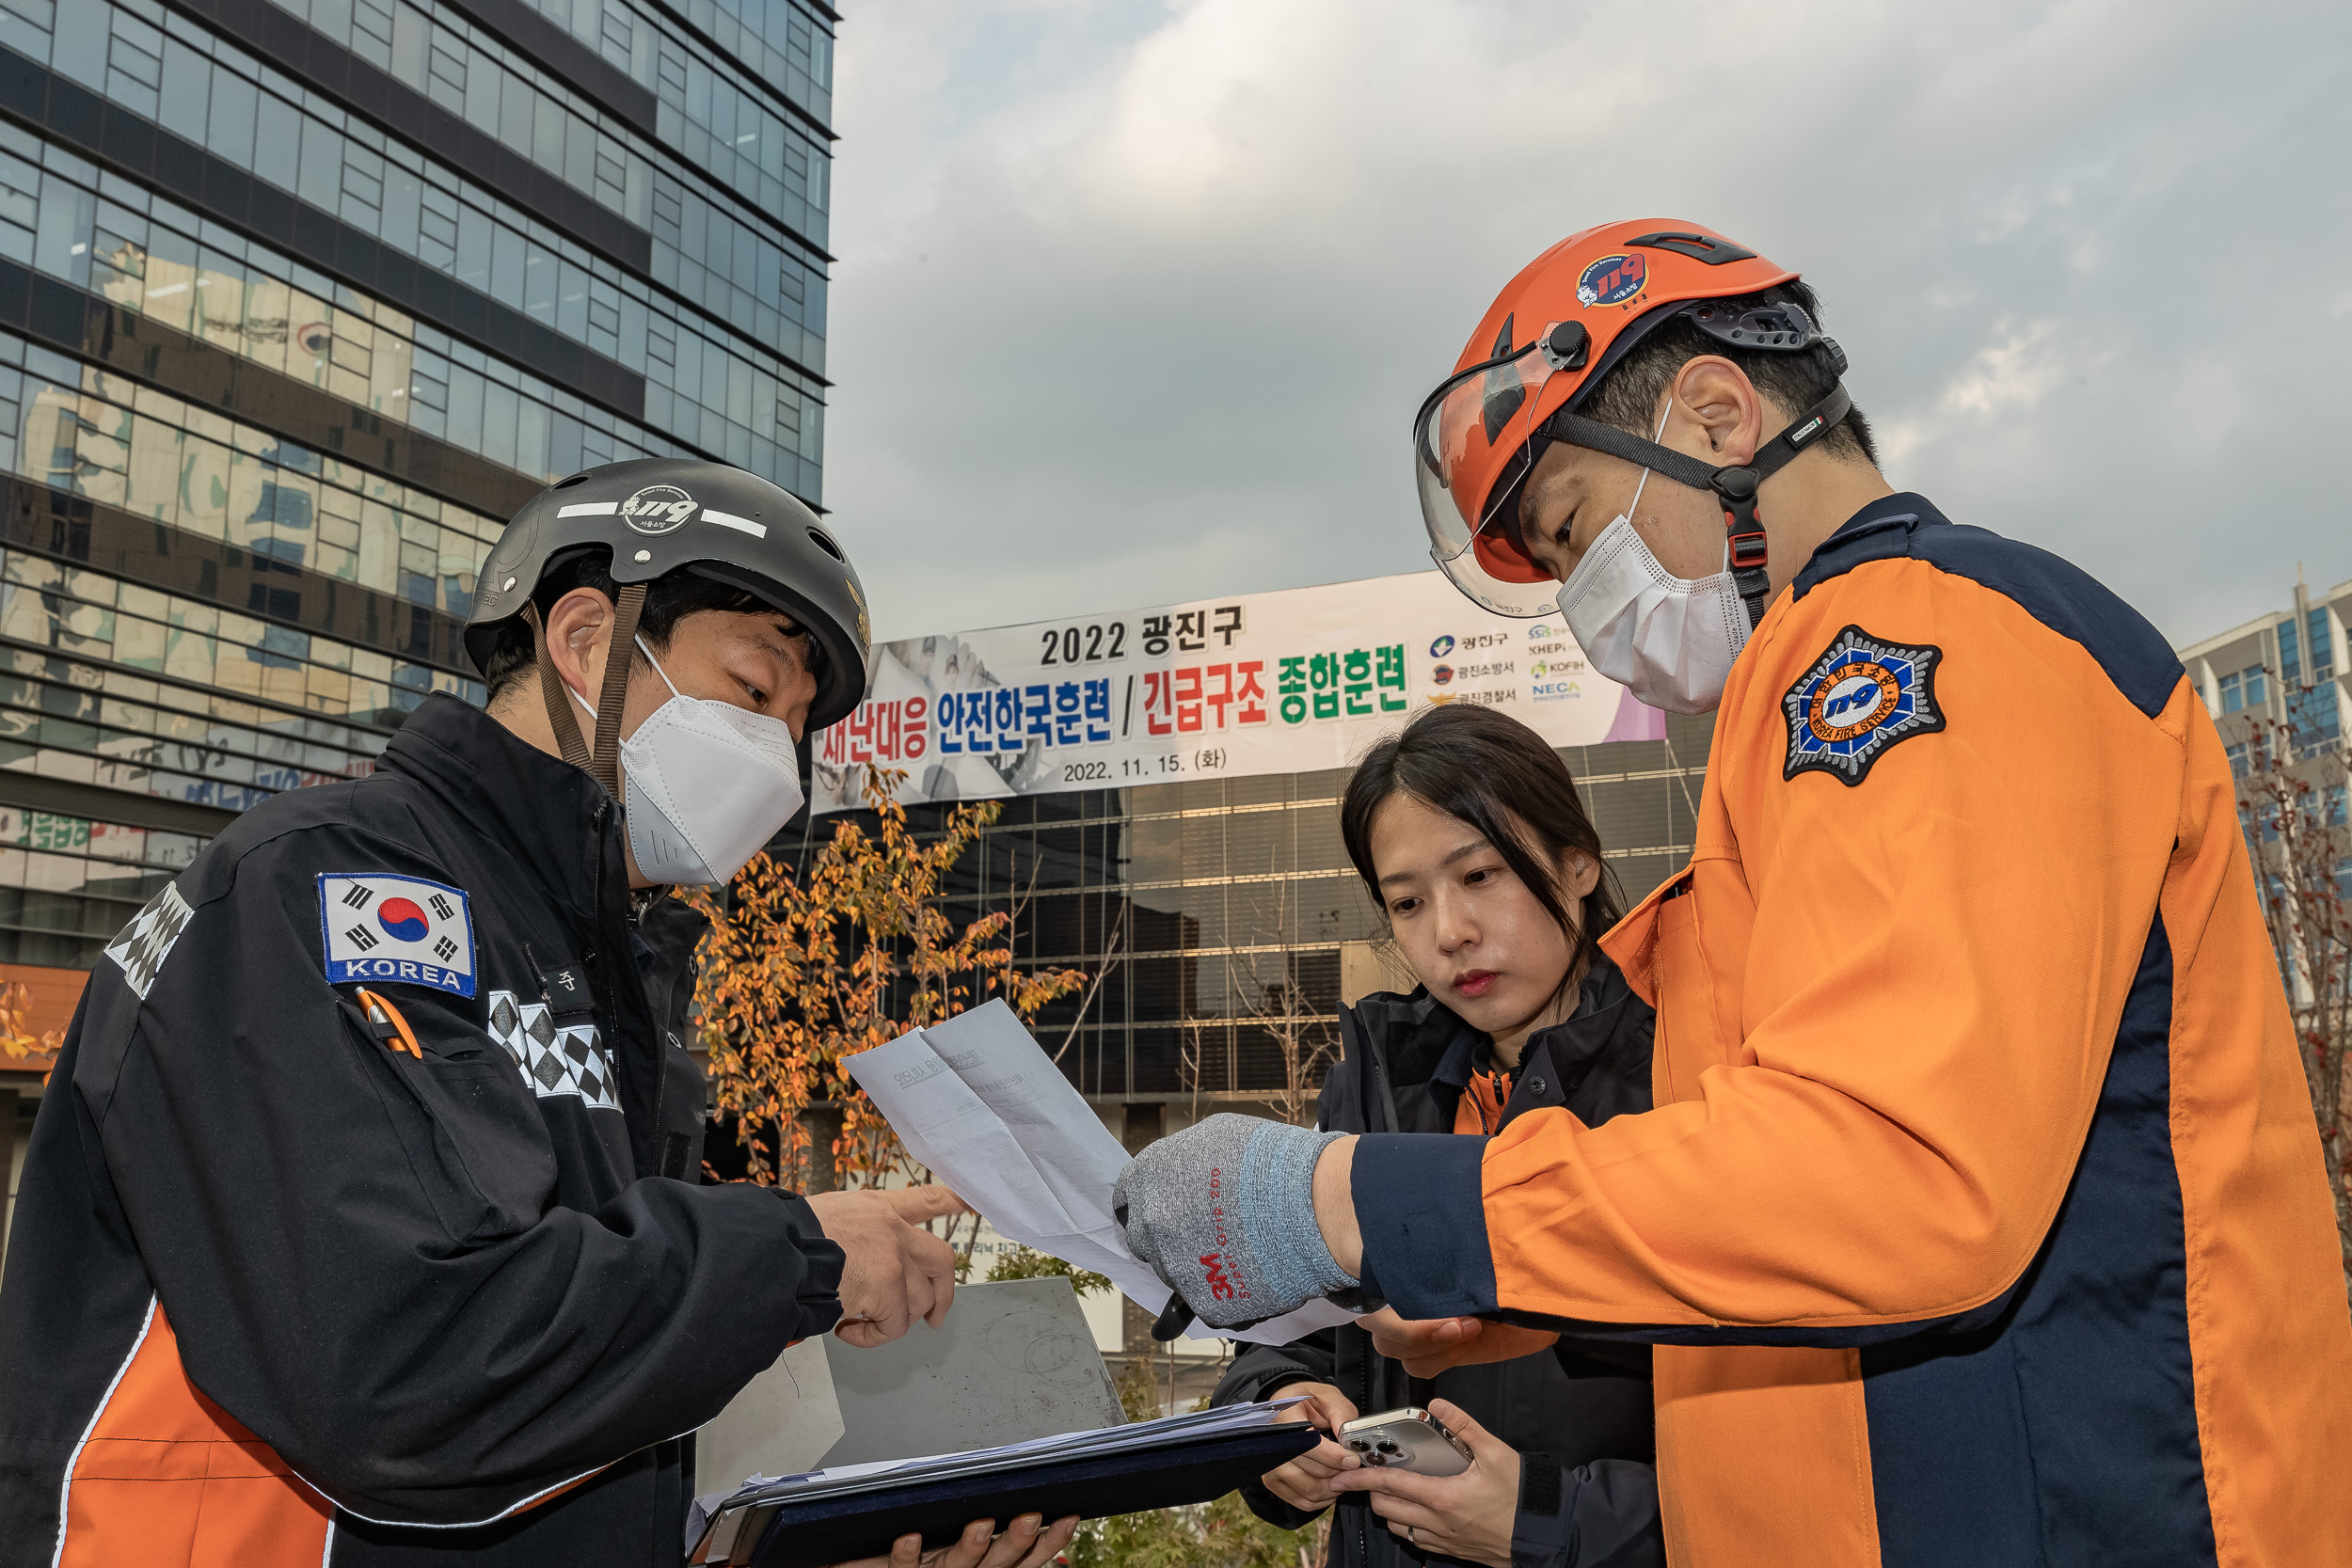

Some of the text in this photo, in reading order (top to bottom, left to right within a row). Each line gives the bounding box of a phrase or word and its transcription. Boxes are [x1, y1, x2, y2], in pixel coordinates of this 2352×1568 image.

[1597, 253, 1645, 298] 119
[633, 500, 699, 523] 119
[640, 520, 666, 529] 서울소방
[1725, 594, 1735, 617] Korea
[1041, 606, 1242, 665] 2022 광진구
[1460, 632, 1508, 650] 광진구
[1458, 660, 1515, 680] 광진소방서
[937, 677, 1111, 753] 안전한국훈련
[1122, 675, 1134, 736] /
[1144, 660, 1266, 736] 긴급구조
[1278, 643, 1407, 724] 종합훈련
[1532, 681, 1580, 695] NECA
[1825, 683, 1880, 721] 119
[1811, 697, 1897, 739] KOREA FIRE SERVICE
[1064, 747, 1227, 782] 2022. 11. 15. (화)
[345, 959, 461, 990] KOREA
[1210, 1167, 1250, 1299] Super Grip 200
[1200, 1252, 1233, 1300] 3M
